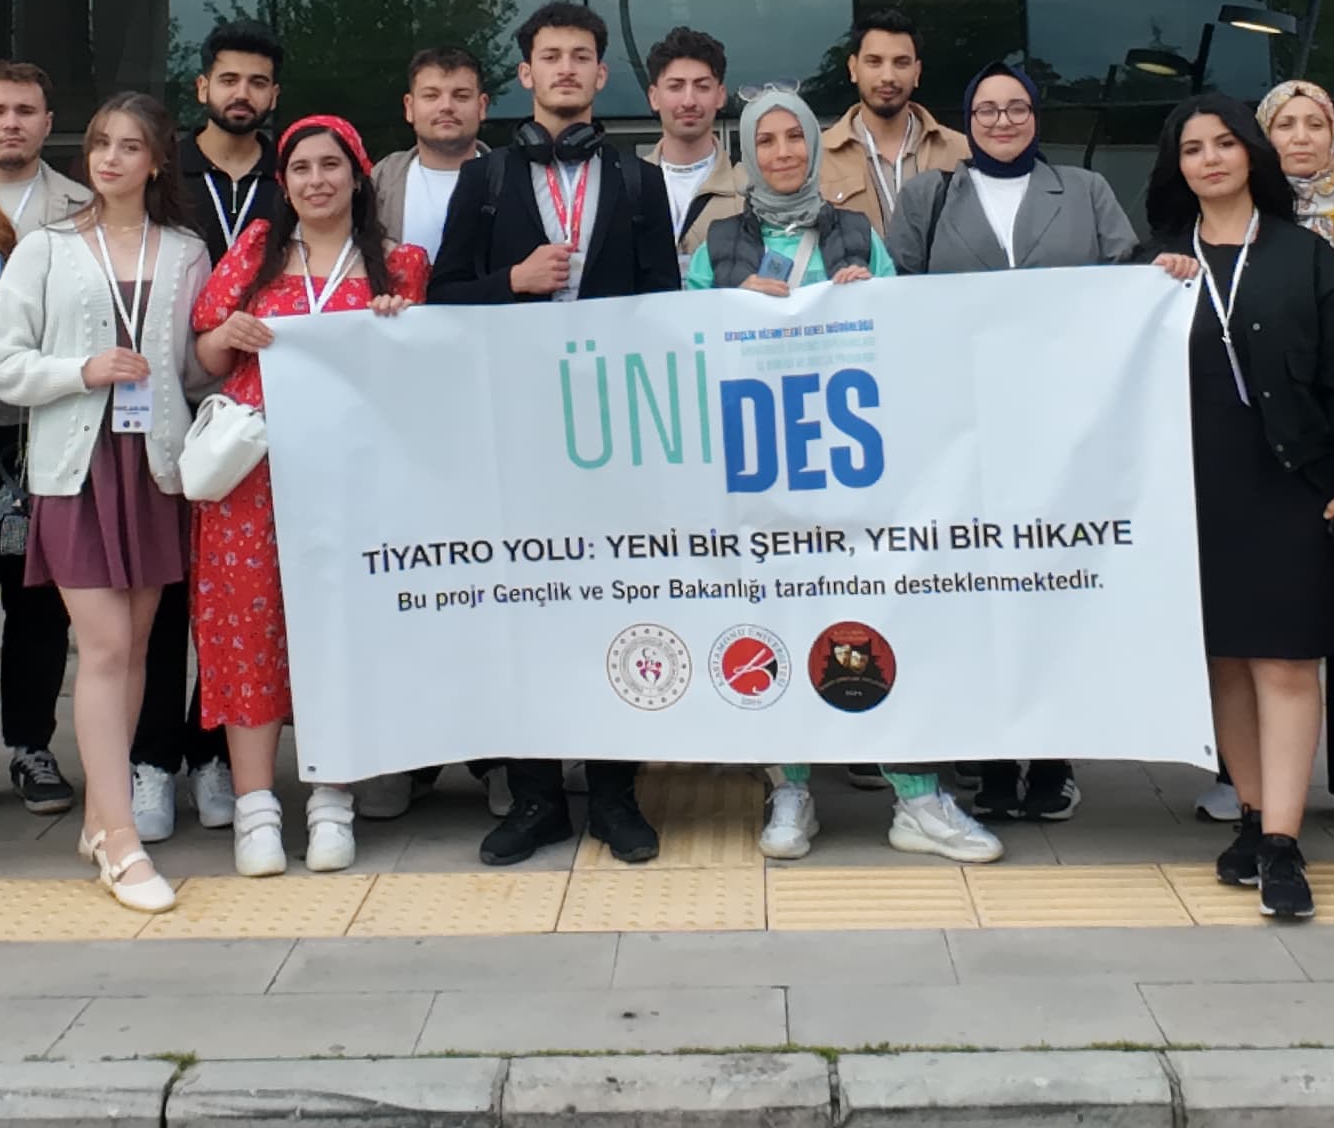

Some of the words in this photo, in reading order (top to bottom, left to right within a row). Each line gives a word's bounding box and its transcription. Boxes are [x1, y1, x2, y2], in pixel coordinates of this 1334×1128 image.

[719, 368, 885, 493] DES
[361, 541, 494, 575] TİYATRO
[502, 536, 595, 563] YOLU:
[605, 527, 679, 560] YENİ
[688, 528, 742, 558] BİR
[750, 525, 855, 564] ŞEHİR,
[864, 519, 939, 552] YENİ
[949, 517, 1004, 550] BİR
[1013, 517, 1134, 549] HİKAYE
[397, 591, 427, 612] Bu
[435, 588, 486, 611] projr
[492, 581, 573, 608] Gençlik
[579, 585, 604, 601] ve
[611, 579, 661, 604] Spor
[668, 576, 767, 604] Bakanlığı
[774, 574, 886, 599] tarafından
[894, 569, 1105, 595] desteklenmektedir.
